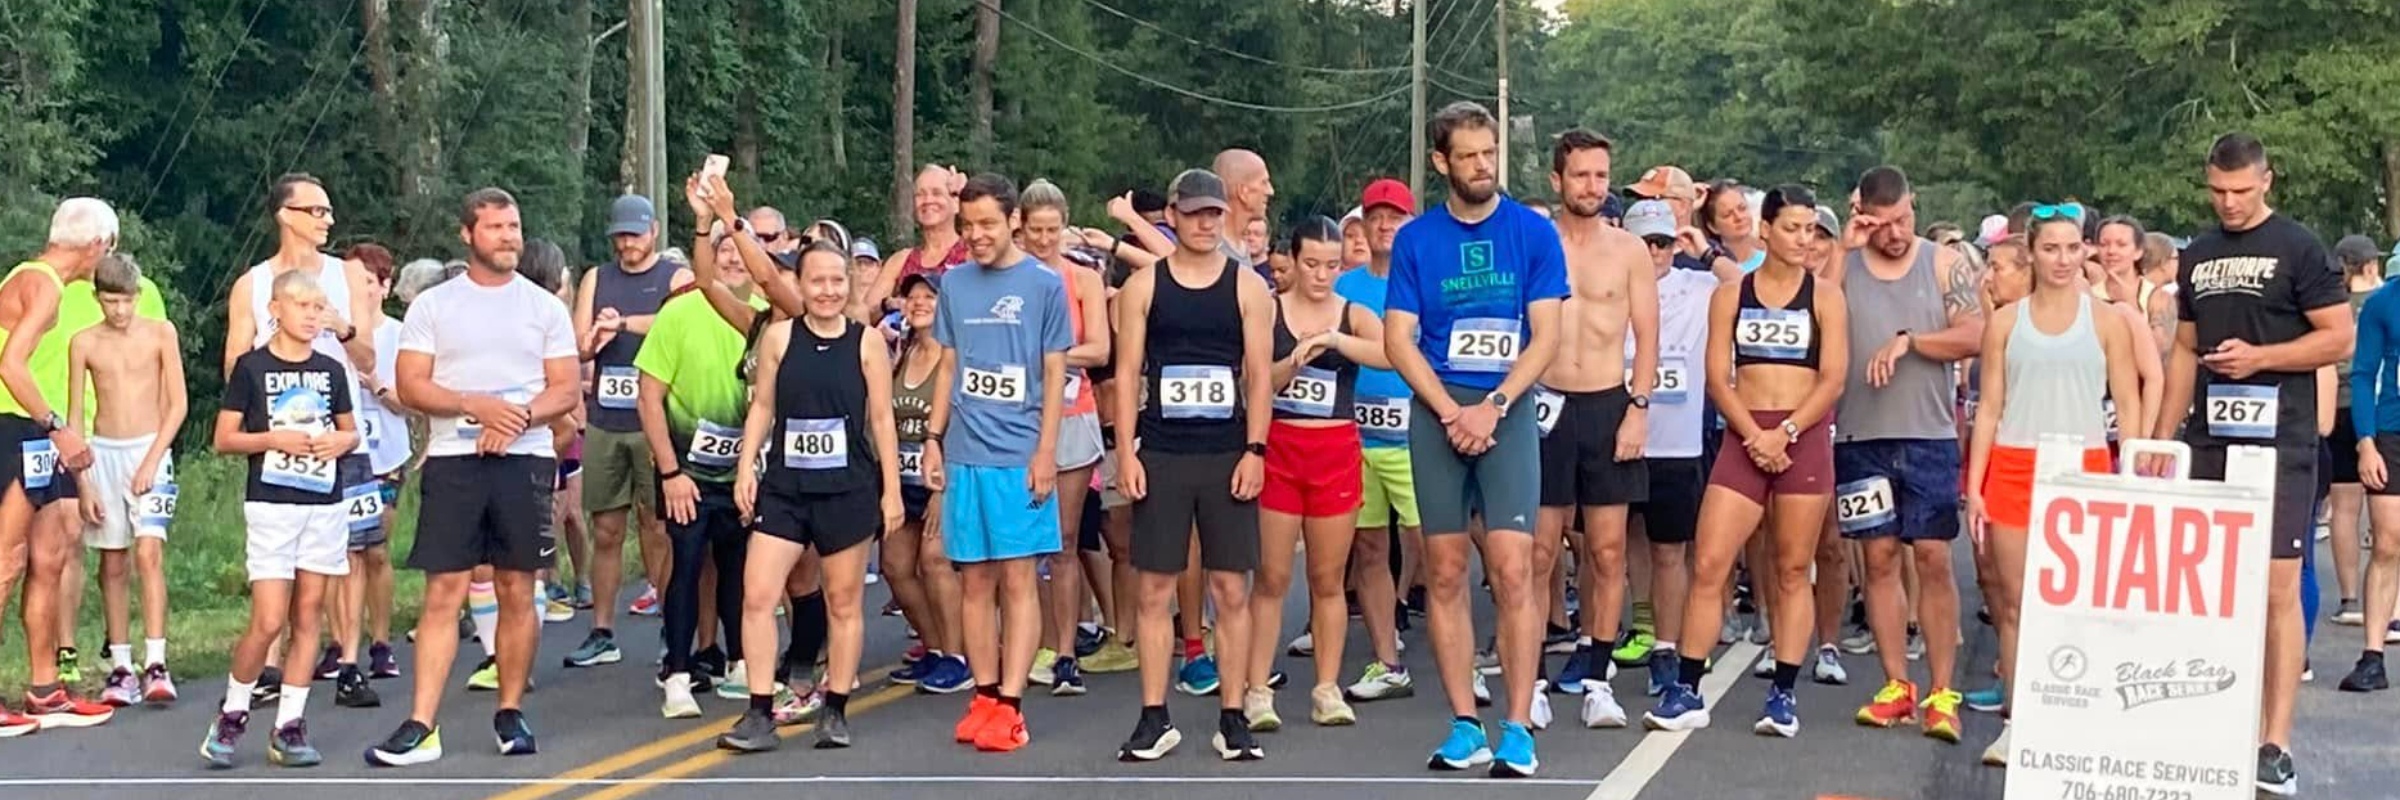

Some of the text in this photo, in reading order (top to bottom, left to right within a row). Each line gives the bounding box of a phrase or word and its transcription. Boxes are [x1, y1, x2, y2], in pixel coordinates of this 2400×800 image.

[1468, 246, 1485, 268] S
[1457, 333, 1512, 357] 250
[1745, 322, 1800, 345] 325
[264, 371, 332, 393] EXPLORE
[605, 378, 640, 396] 36
[966, 371, 1016, 398] 395
[1169, 381, 1226, 403] 318
[1355, 405, 1402, 427] 385
[2213, 400, 2266, 422] 267
[794, 433, 834, 455] 480
[274, 450, 328, 478] 352
[1839, 490, 1885, 518] 321
[2038, 497, 2255, 619] START
[2115, 658, 2229, 683] Black Bag
[2019, 748, 2239, 787] CLASSIC RACE SERVICES
